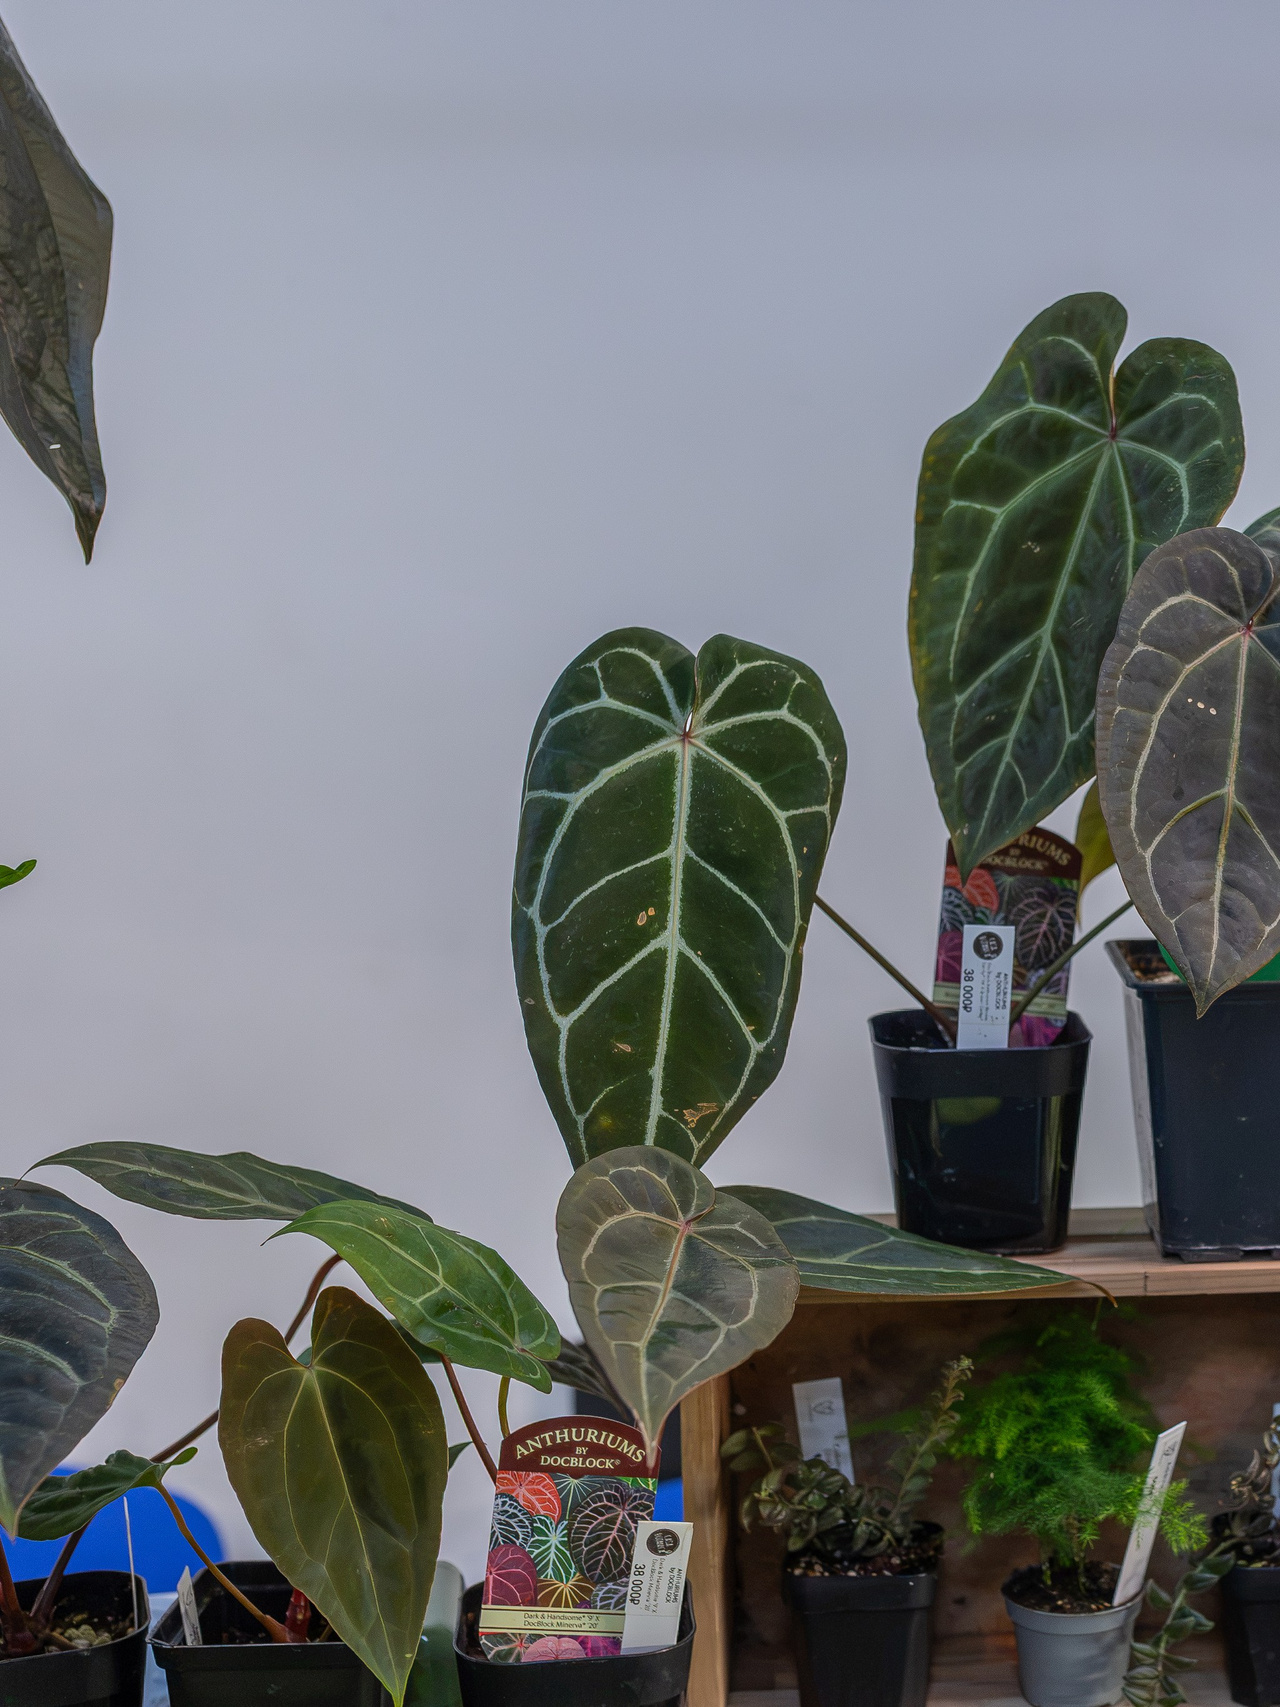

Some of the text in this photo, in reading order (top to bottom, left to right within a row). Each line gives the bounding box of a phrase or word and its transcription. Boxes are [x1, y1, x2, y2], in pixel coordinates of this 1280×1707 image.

[964, 968, 974, 982] 38
[515, 1427, 646, 1463] ANTHURIUMS
[575, 1447, 589, 1455] BY
[634, 1563, 646, 1576] 38
[665, 1574, 675, 1604] DOCBLOCK
[672, 1568, 683, 1603] ANTHURIUMS
